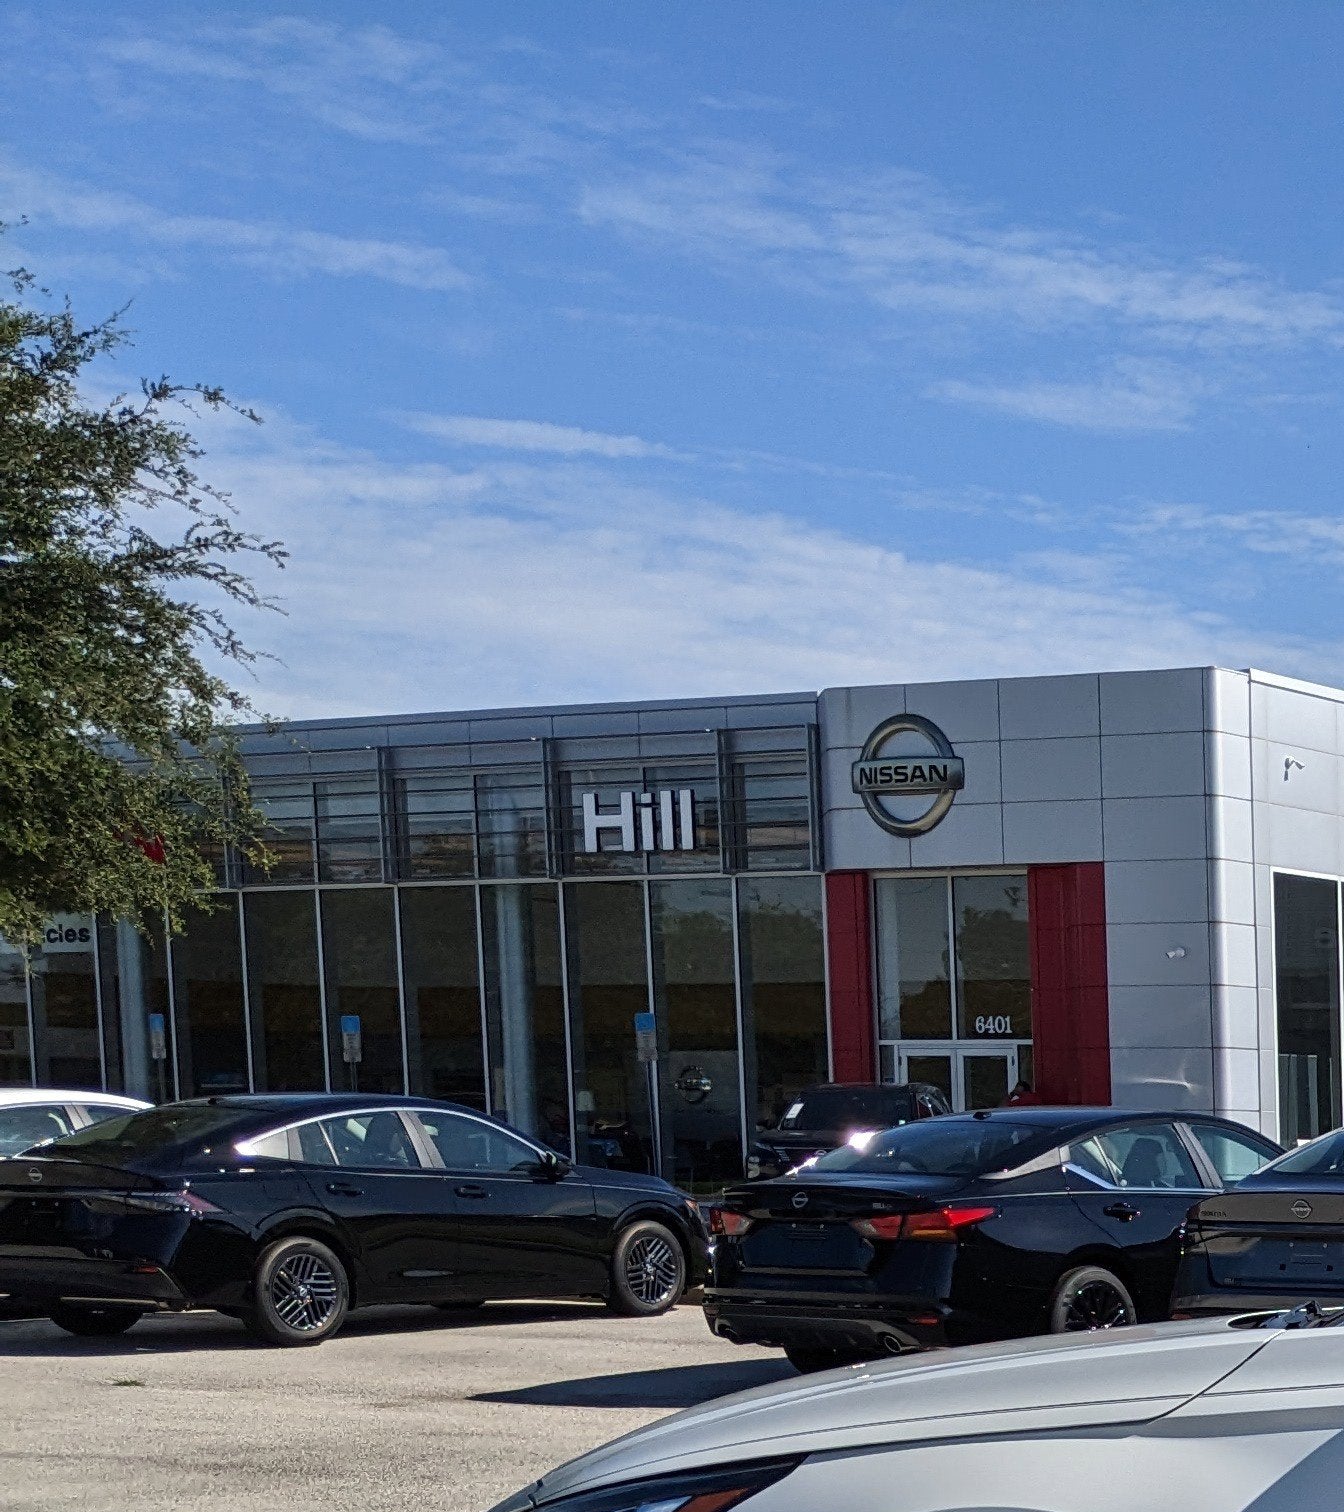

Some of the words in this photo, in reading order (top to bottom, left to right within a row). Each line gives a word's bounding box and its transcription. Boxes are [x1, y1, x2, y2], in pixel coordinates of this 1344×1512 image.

[860, 764, 948, 786] NISSAN
[582, 789, 694, 853] Hill
[975, 1015, 1013, 1034] 6401
